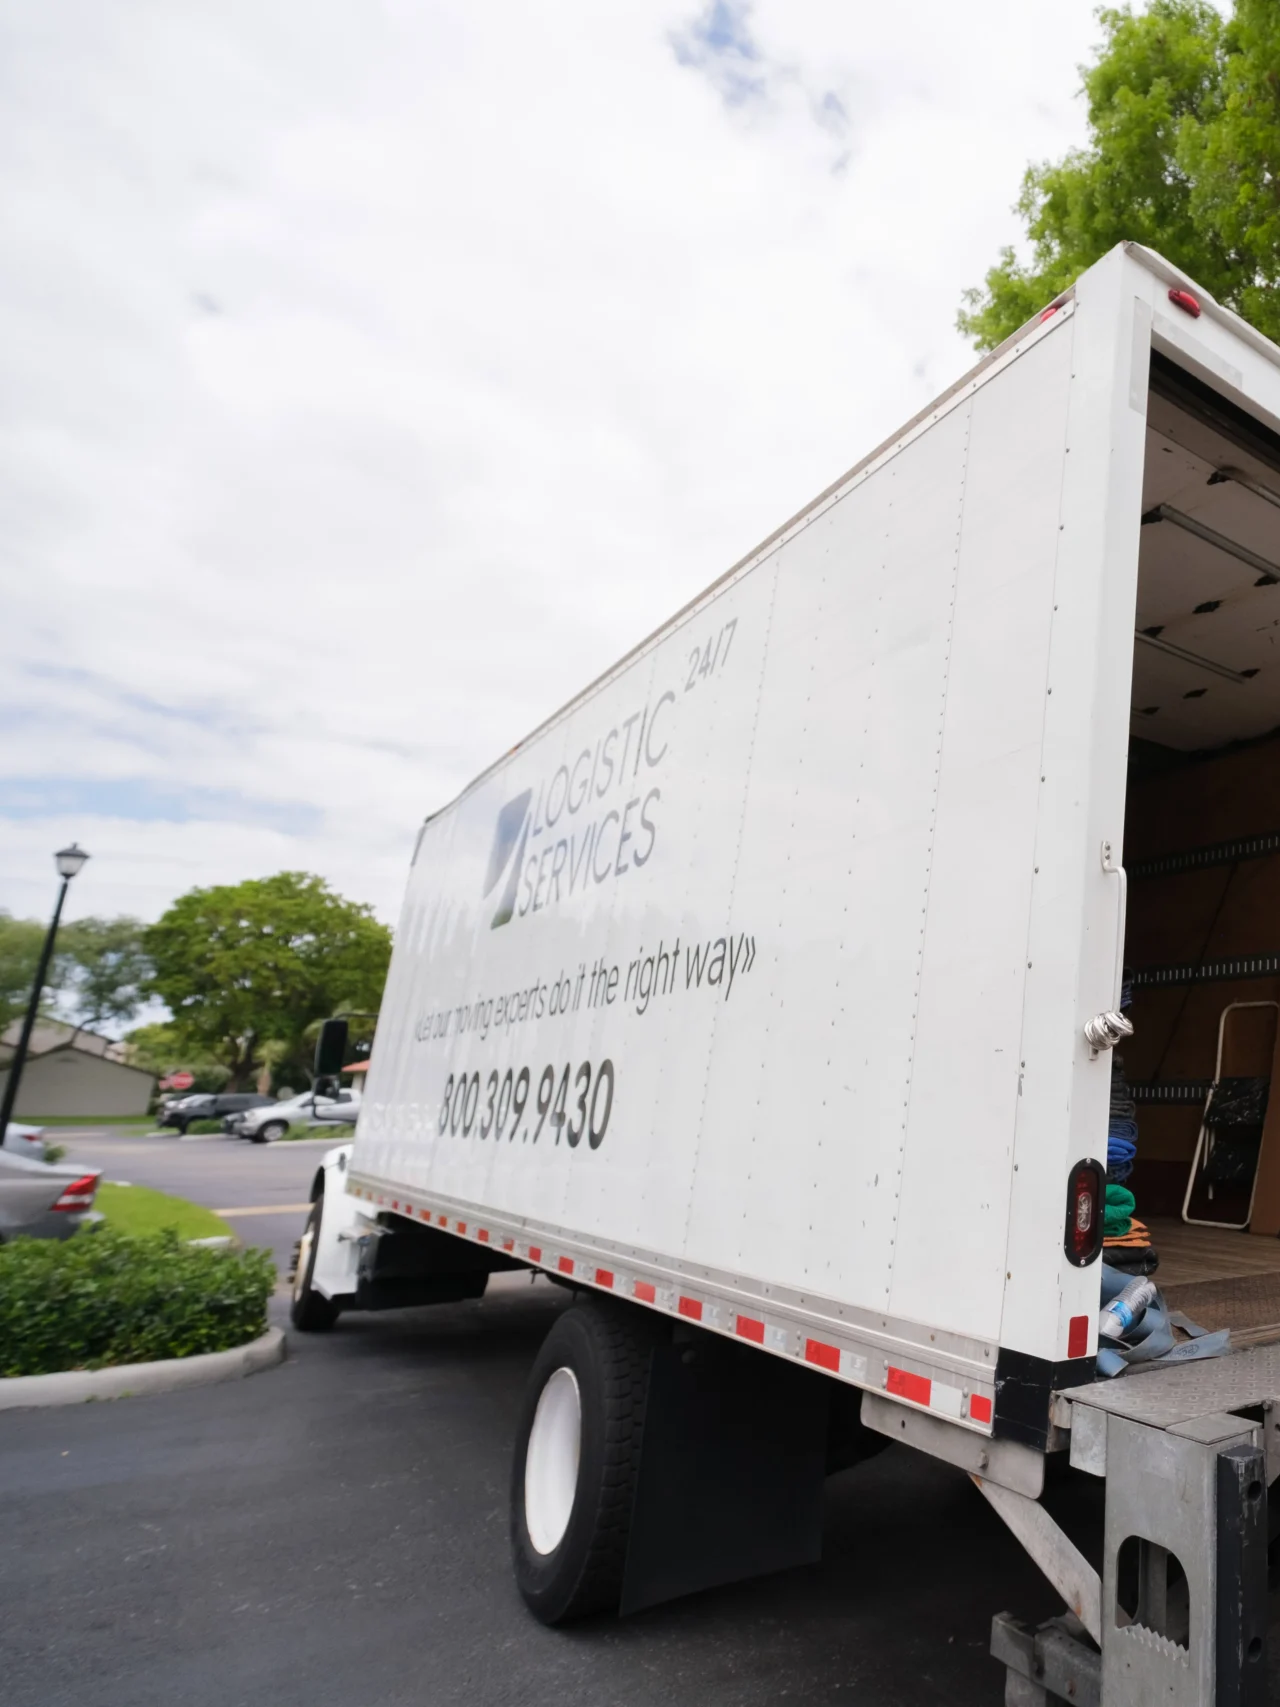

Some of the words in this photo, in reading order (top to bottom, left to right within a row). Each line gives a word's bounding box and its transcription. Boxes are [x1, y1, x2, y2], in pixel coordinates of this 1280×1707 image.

[533, 690, 676, 838] LOGISTIC
[684, 617, 739, 693] 24/7
[518, 788, 661, 918] SERVICES
[494, 976, 548, 1037] experts
[549, 969, 571, 1016] do
[570, 961, 587, 1012] it
[587, 957, 619, 1009] the
[624, 936, 681, 1016] right
[438, 1058, 615, 1150] 800.309.9430
